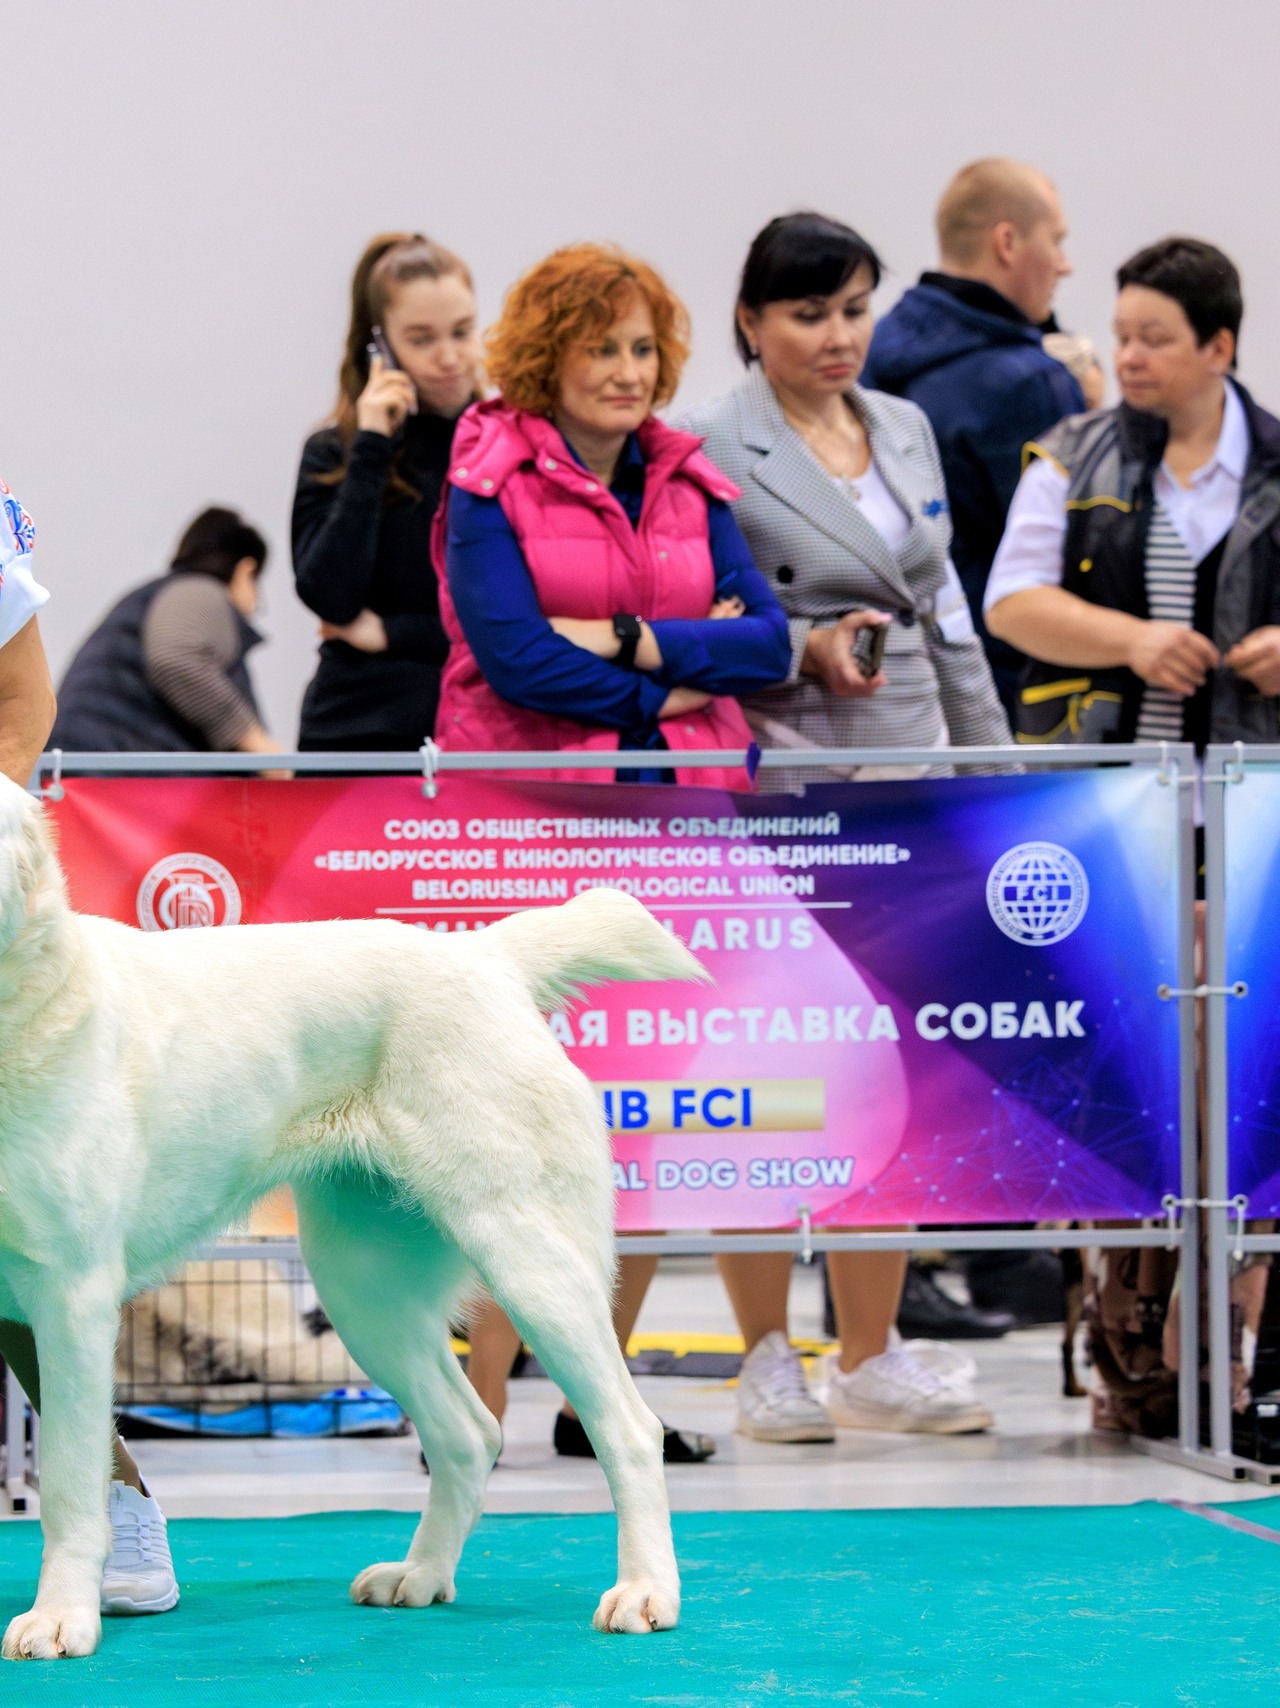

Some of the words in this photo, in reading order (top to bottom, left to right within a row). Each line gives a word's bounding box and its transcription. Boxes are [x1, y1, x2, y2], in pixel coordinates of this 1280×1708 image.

[383, 818, 460, 841] СОЮЗ
[466, 817, 661, 842] ОБЩЕСТВЕННЫХ
[669, 811, 840, 840] ОБЪЕДИНЕНИЙ
[314, 848, 498, 872] «БЕЛОРУССКОЕ
[503, 846, 723, 870] КИНОЛОГИЧЕСКОЕ
[727, 843, 911, 869] ОБЪЕДИНЕНИЕ»
[411, 878, 568, 900] BELORUSSIAN
[739, 874, 815, 896] UNION
[663, 917, 815, 951] ARUS
[626, 1004, 900, 1047] ВЫСТАВКА
[915, 1000, 1086, 1041] СОБАК
[672, 1087, 752, 1129] FCI
[656, 1158, 739, 1191] DOG
[747, 1155, 856, 1189] SHOW
